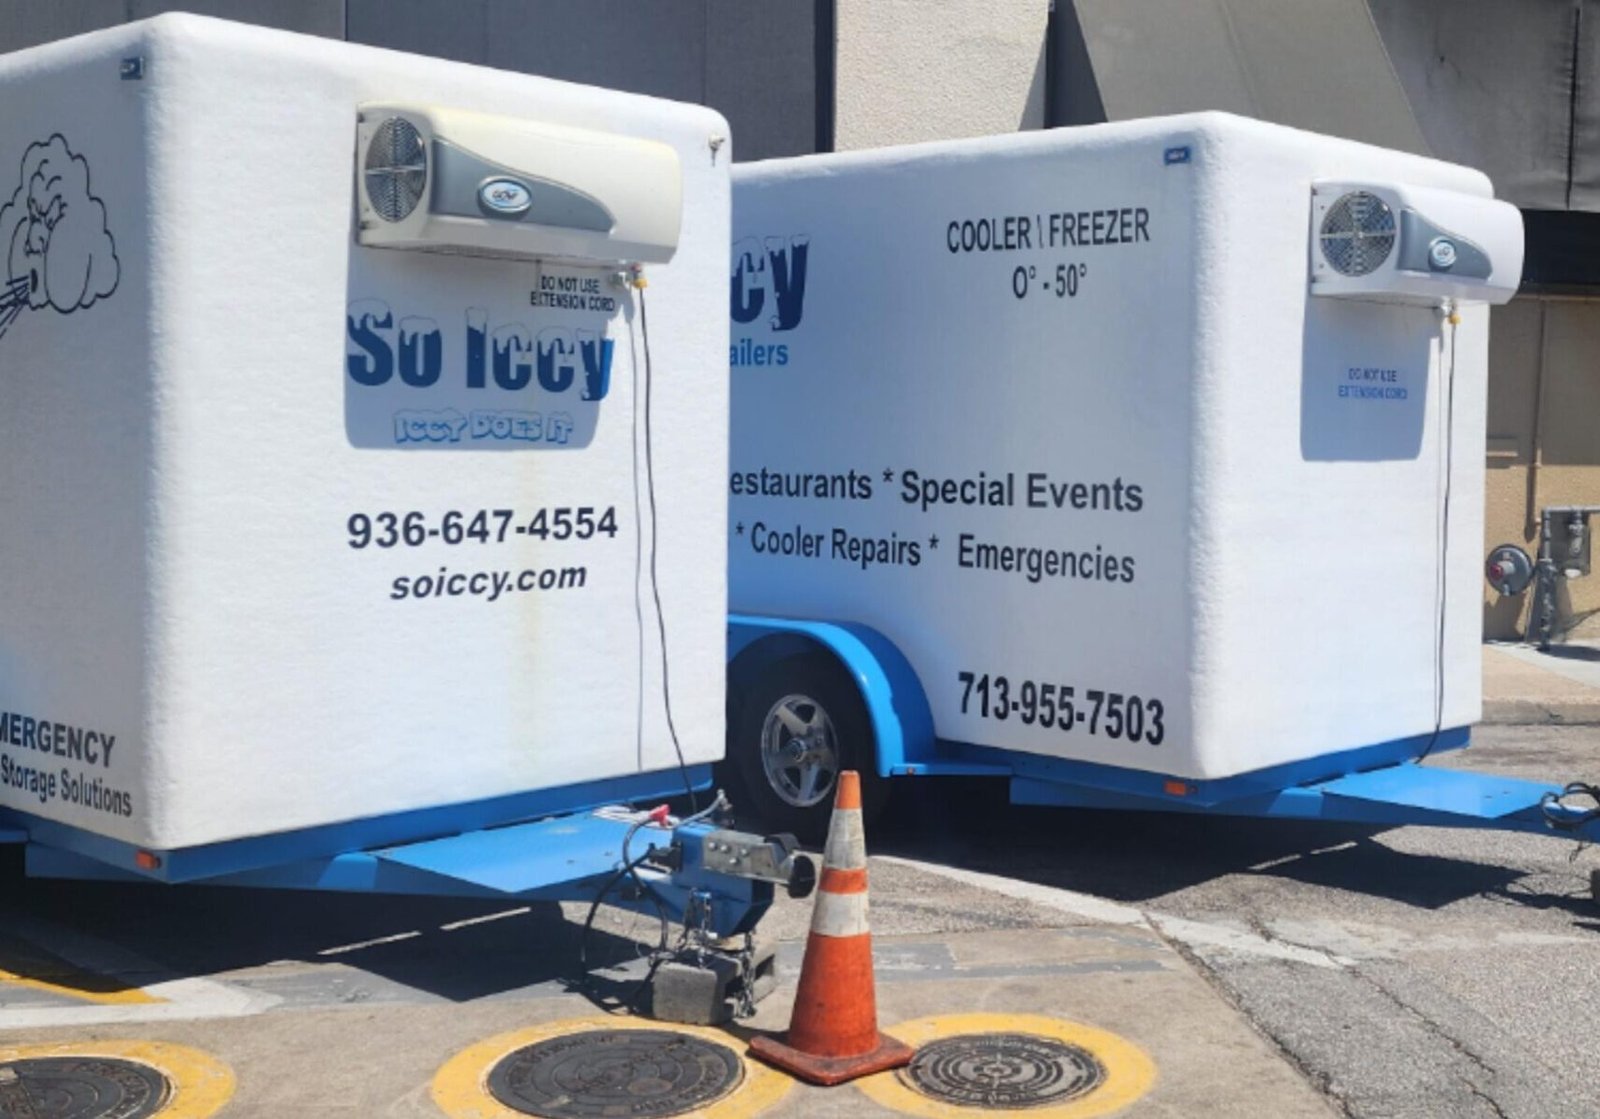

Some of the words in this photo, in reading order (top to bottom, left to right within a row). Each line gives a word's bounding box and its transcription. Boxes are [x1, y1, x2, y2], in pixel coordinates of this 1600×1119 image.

[946, 217, 1032, 254] COOLER
[1049, 207, 1150, 248] FREEZER
[529, 290, 587, 311] EXTENSION
[588, 295, 616, 312] CORD
[541, 275, 556, 291] DO
[558, 276, 578, 293] NOT
[580, 278, 601, 295] USE
[346, 299, 443, 388] So
[465, 306, 616, 402] Iccy
[900, 469, 1014, 512] Special
[1026, 472, 1145, 513] Events
[346, 505, 619, 550] 936-647-4554
[750, 521, 825, 558] Cooler
[831, 527, 921, 571] Repairs
[957, 532, 1136, 584] Emergencies
[389, 565, 588, 602] soiccy.com
[957, 670, 1166, 747] 713-955-7503
[0, 752, 56, 803] Storage
[60, 767, 133, 818] Solutions
